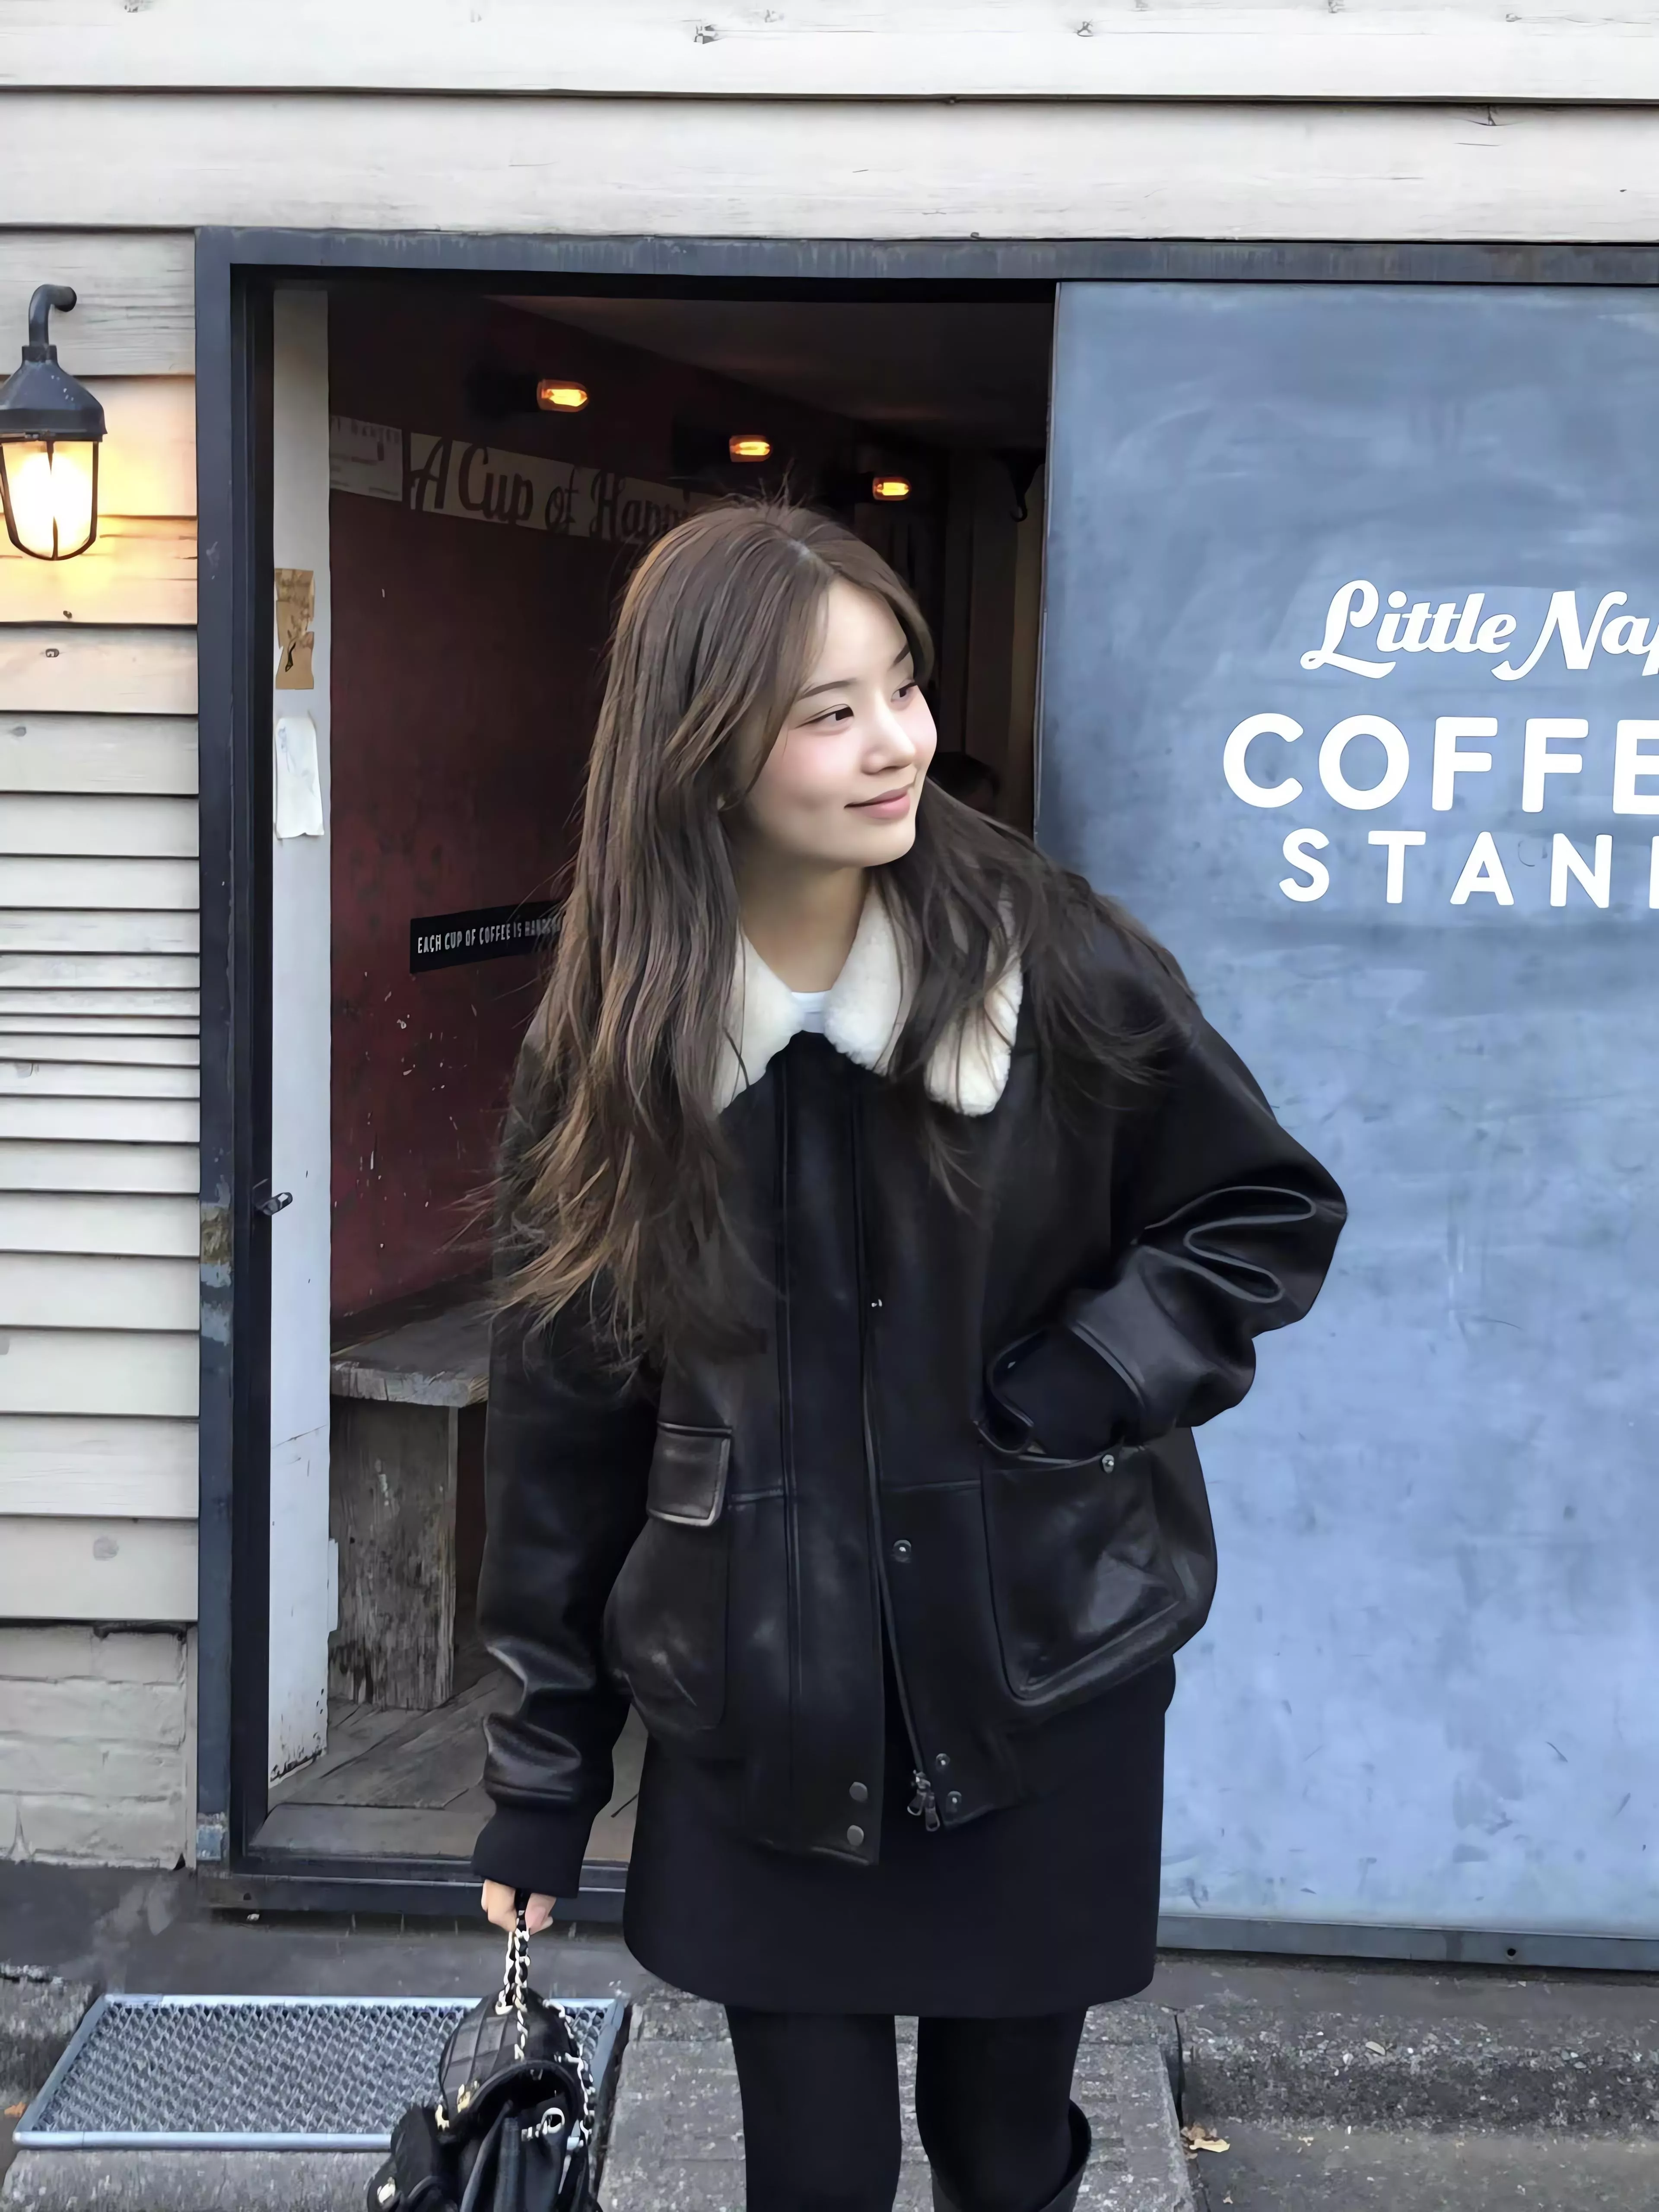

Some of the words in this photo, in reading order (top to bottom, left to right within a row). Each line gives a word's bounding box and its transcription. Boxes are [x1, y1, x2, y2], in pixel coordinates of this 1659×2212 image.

[409, 434, 453, 511] A
[458, 442, 534, 524] Cup
[545, 465, 580, 532] of
[1300, 579, 1517, 679] Little
[1223, 712, 1659, 815] COFFE
[1279, 828, 1659, 909] STAN
[418, 934, 441, 953] EACH
[445, 931, 462, 950] CUP
[465, 928, 476, 946] OF
[479, 923, 511, 945] COFFEE
[513, 922, 522, 938] IS
